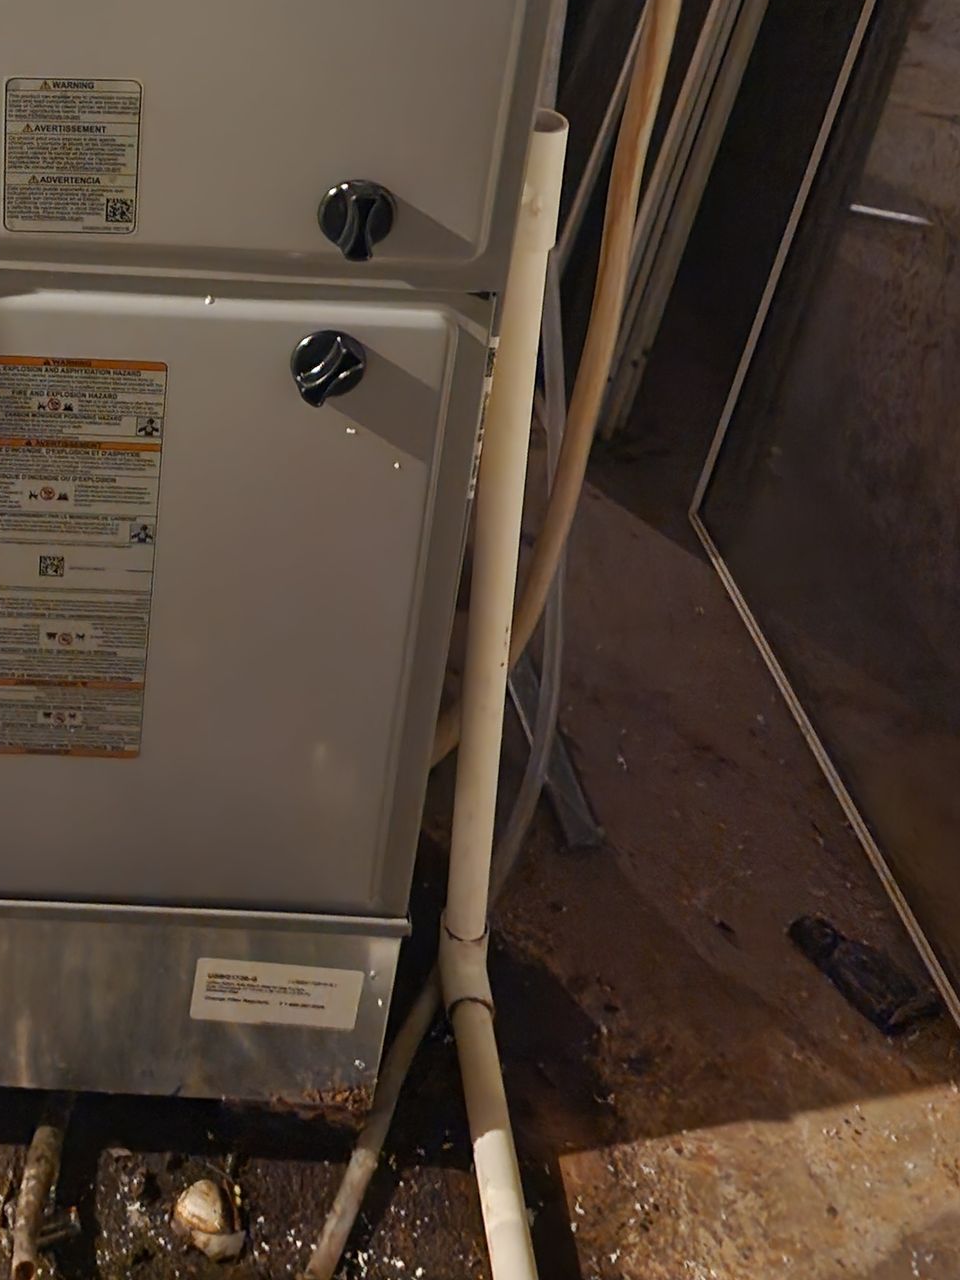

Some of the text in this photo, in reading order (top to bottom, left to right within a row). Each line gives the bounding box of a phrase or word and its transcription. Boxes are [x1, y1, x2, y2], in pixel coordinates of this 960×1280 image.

[52, 81, 95, 90] WARNING
[34, 124, 107, 134] AVERTISSEMENT
[39, 175, 101, 185] ADVERTENCIA
[44, 367, 60, 375] AND
[29, 390, 45, 398] AND
[46, 391, 87, 399] EXPLOSION
[88, 392, 118, 400] HAZARD
